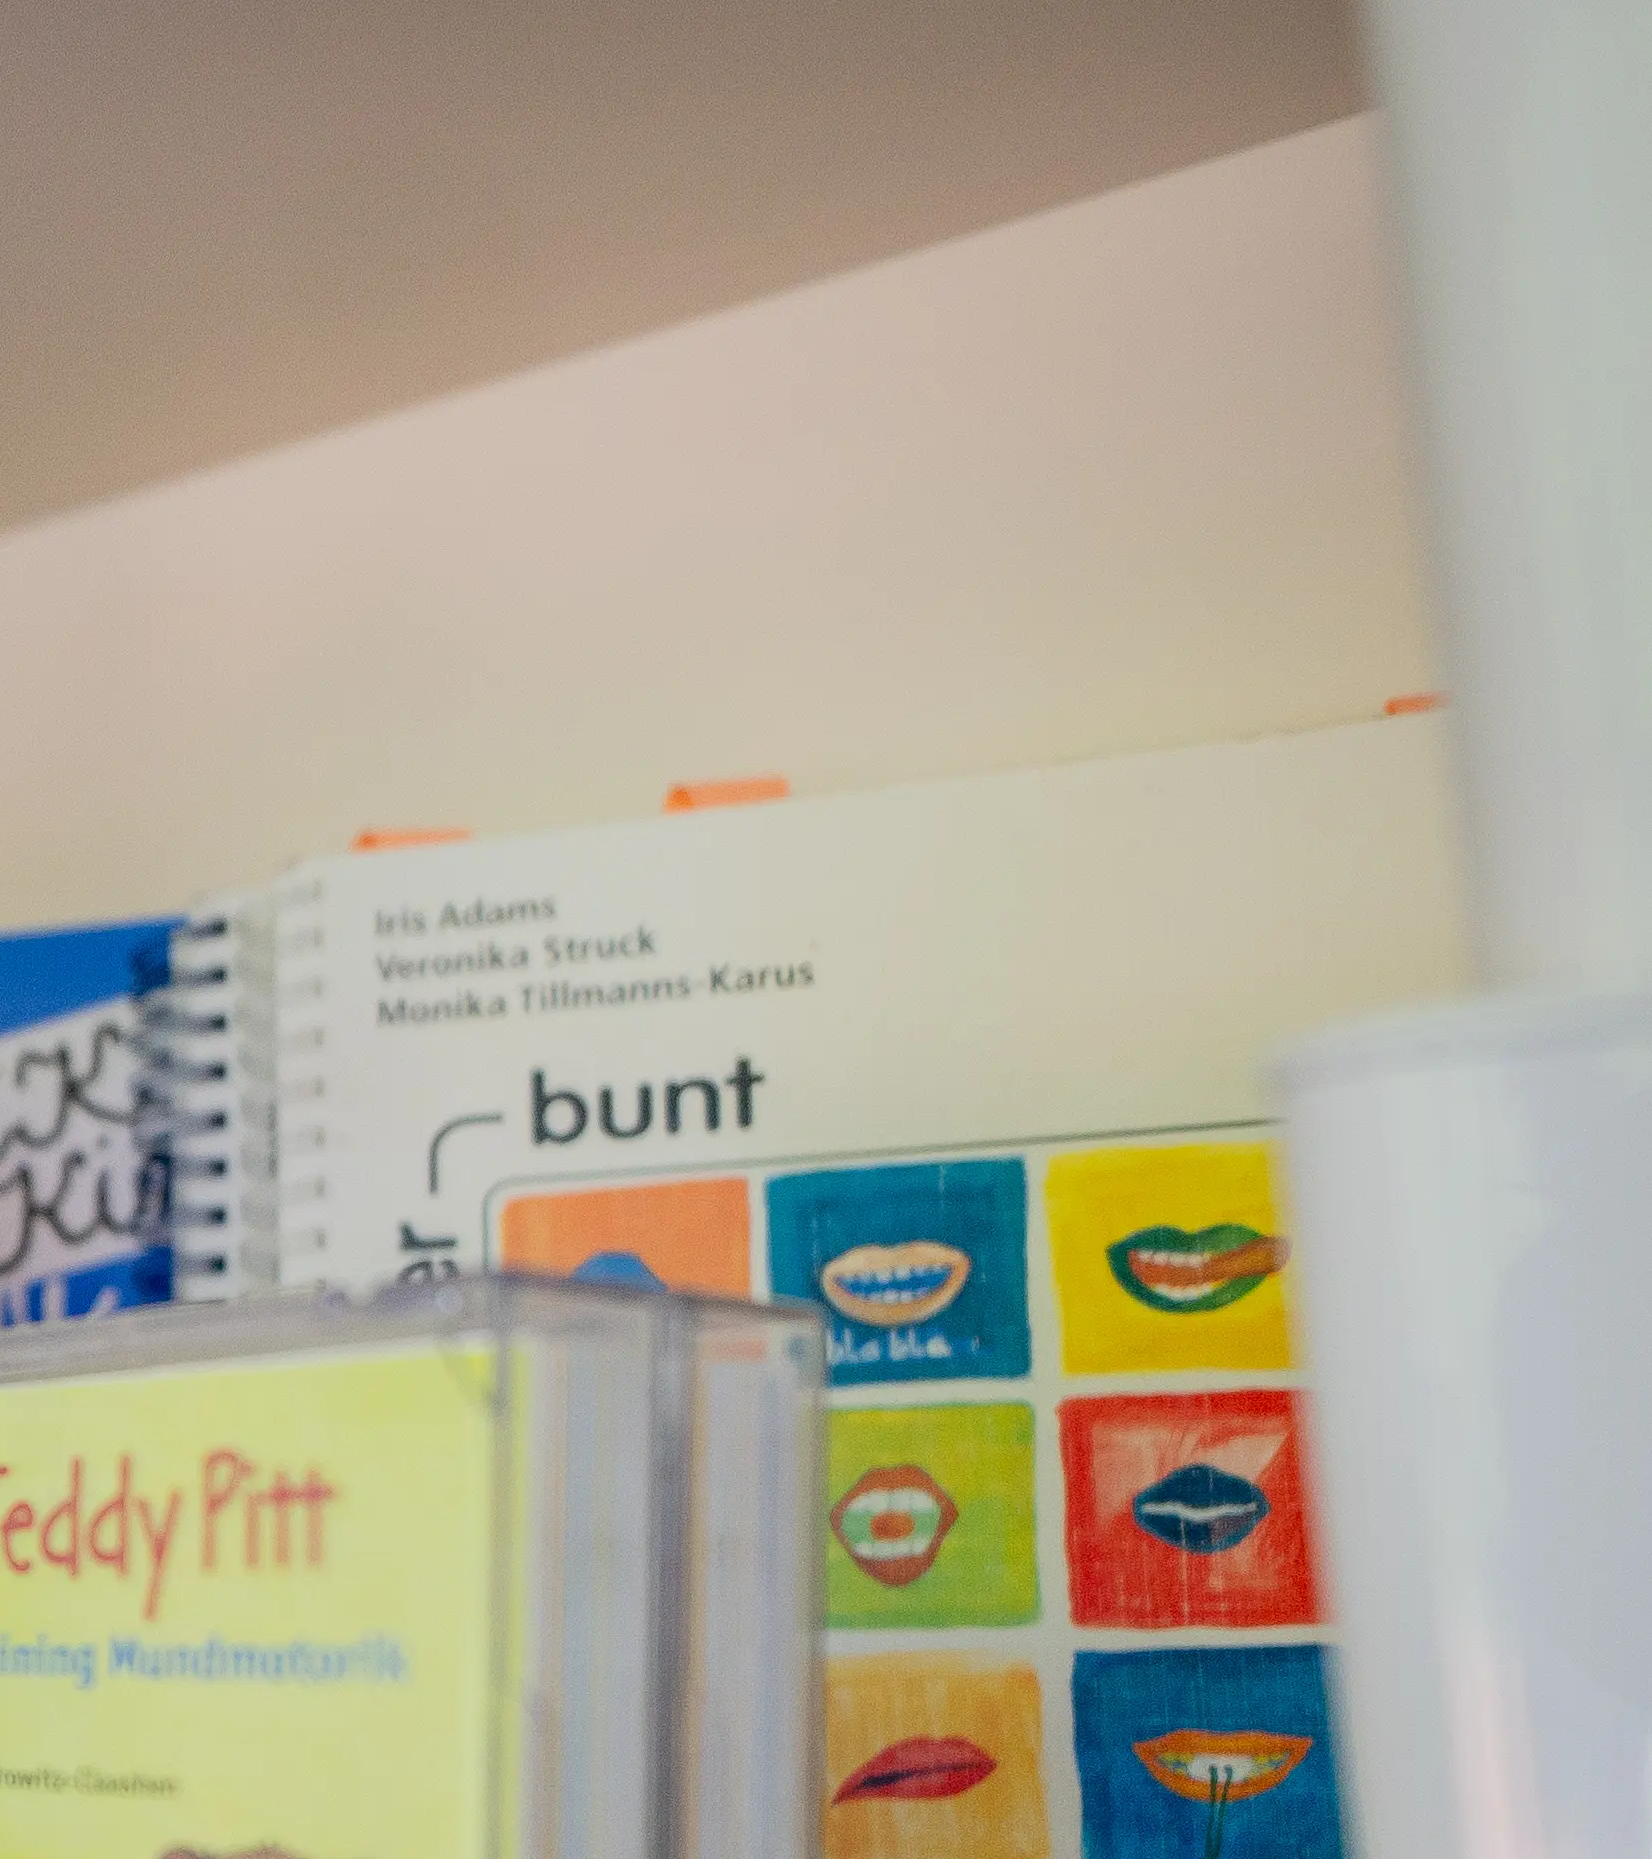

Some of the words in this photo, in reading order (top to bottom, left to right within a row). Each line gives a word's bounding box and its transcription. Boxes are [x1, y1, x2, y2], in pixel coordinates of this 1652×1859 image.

[374, 907, 428, 937] Iris
[438, 896, 557, 931] Adams
[375, 942, 530, 983] Veronika
[543, 923, 657, 965] Struck
[377, 990, 507, 1026] Monika
[528, 1054, 766, 1145] bunt
[200, 1446, 340, 1574] Pitt
